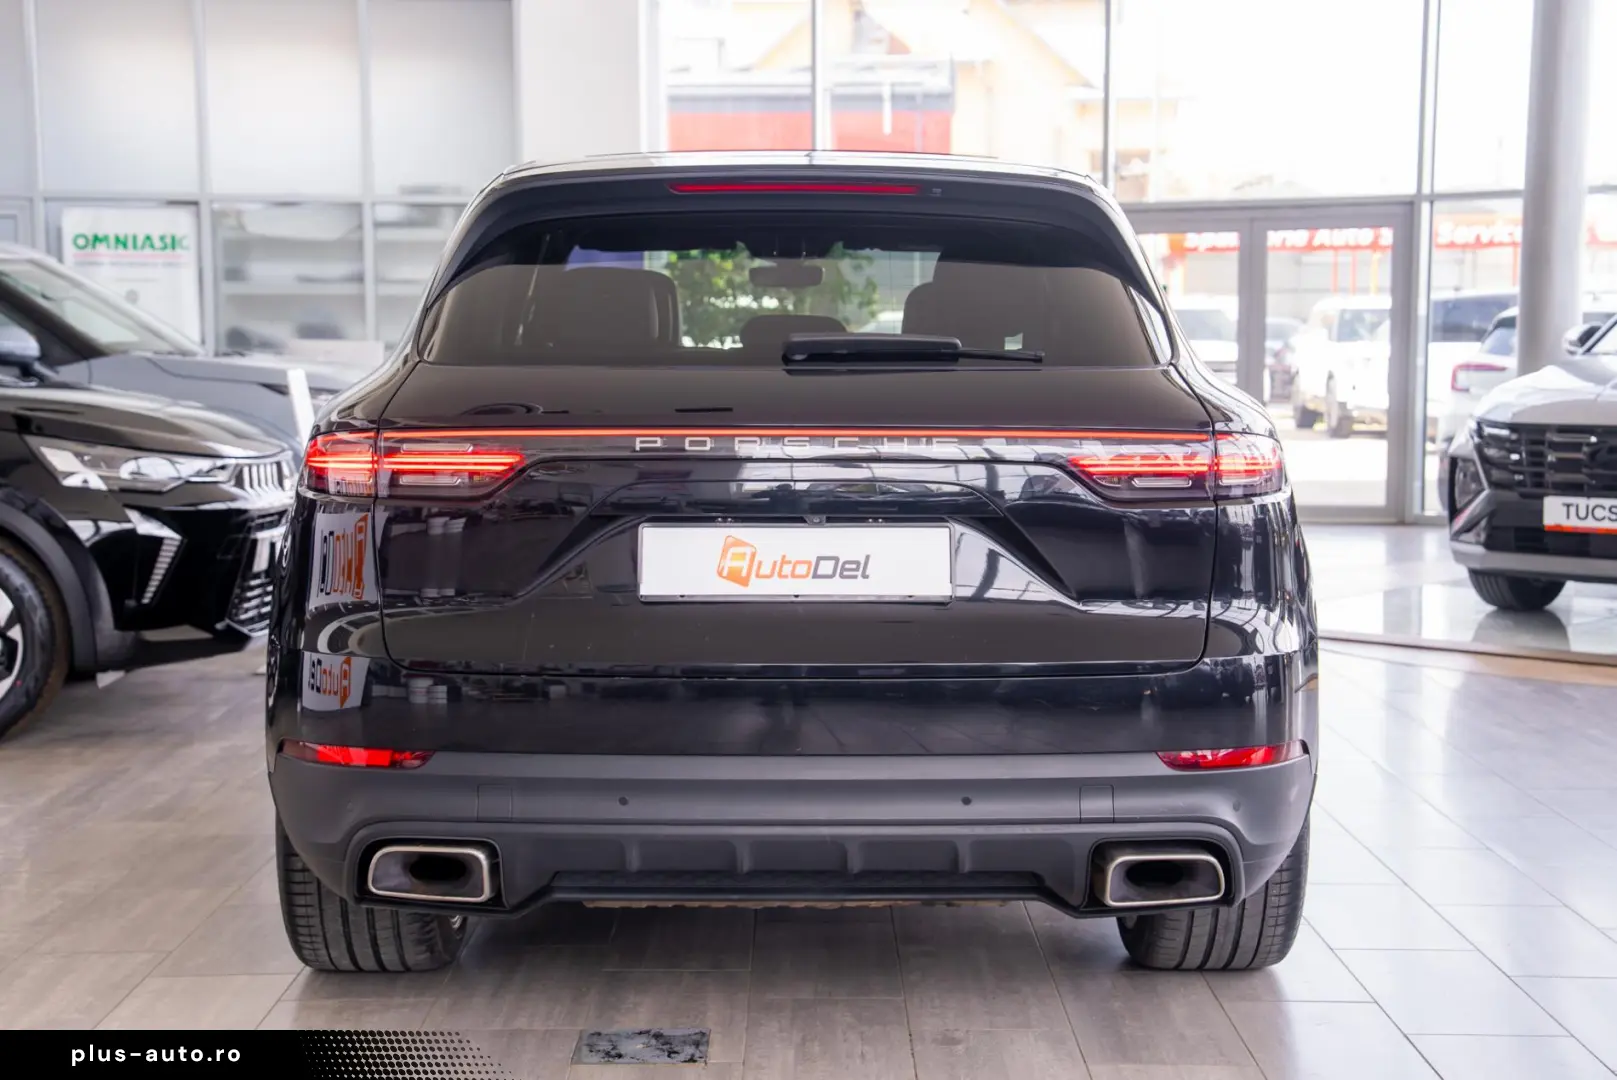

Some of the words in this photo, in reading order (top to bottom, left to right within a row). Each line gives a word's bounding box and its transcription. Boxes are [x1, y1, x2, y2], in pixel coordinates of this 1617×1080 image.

[635, 436, 959, 451] PORSCHE
[1561, 502, 1617, 522] TUCS
[718, 543, 871, 582] AutoDel
